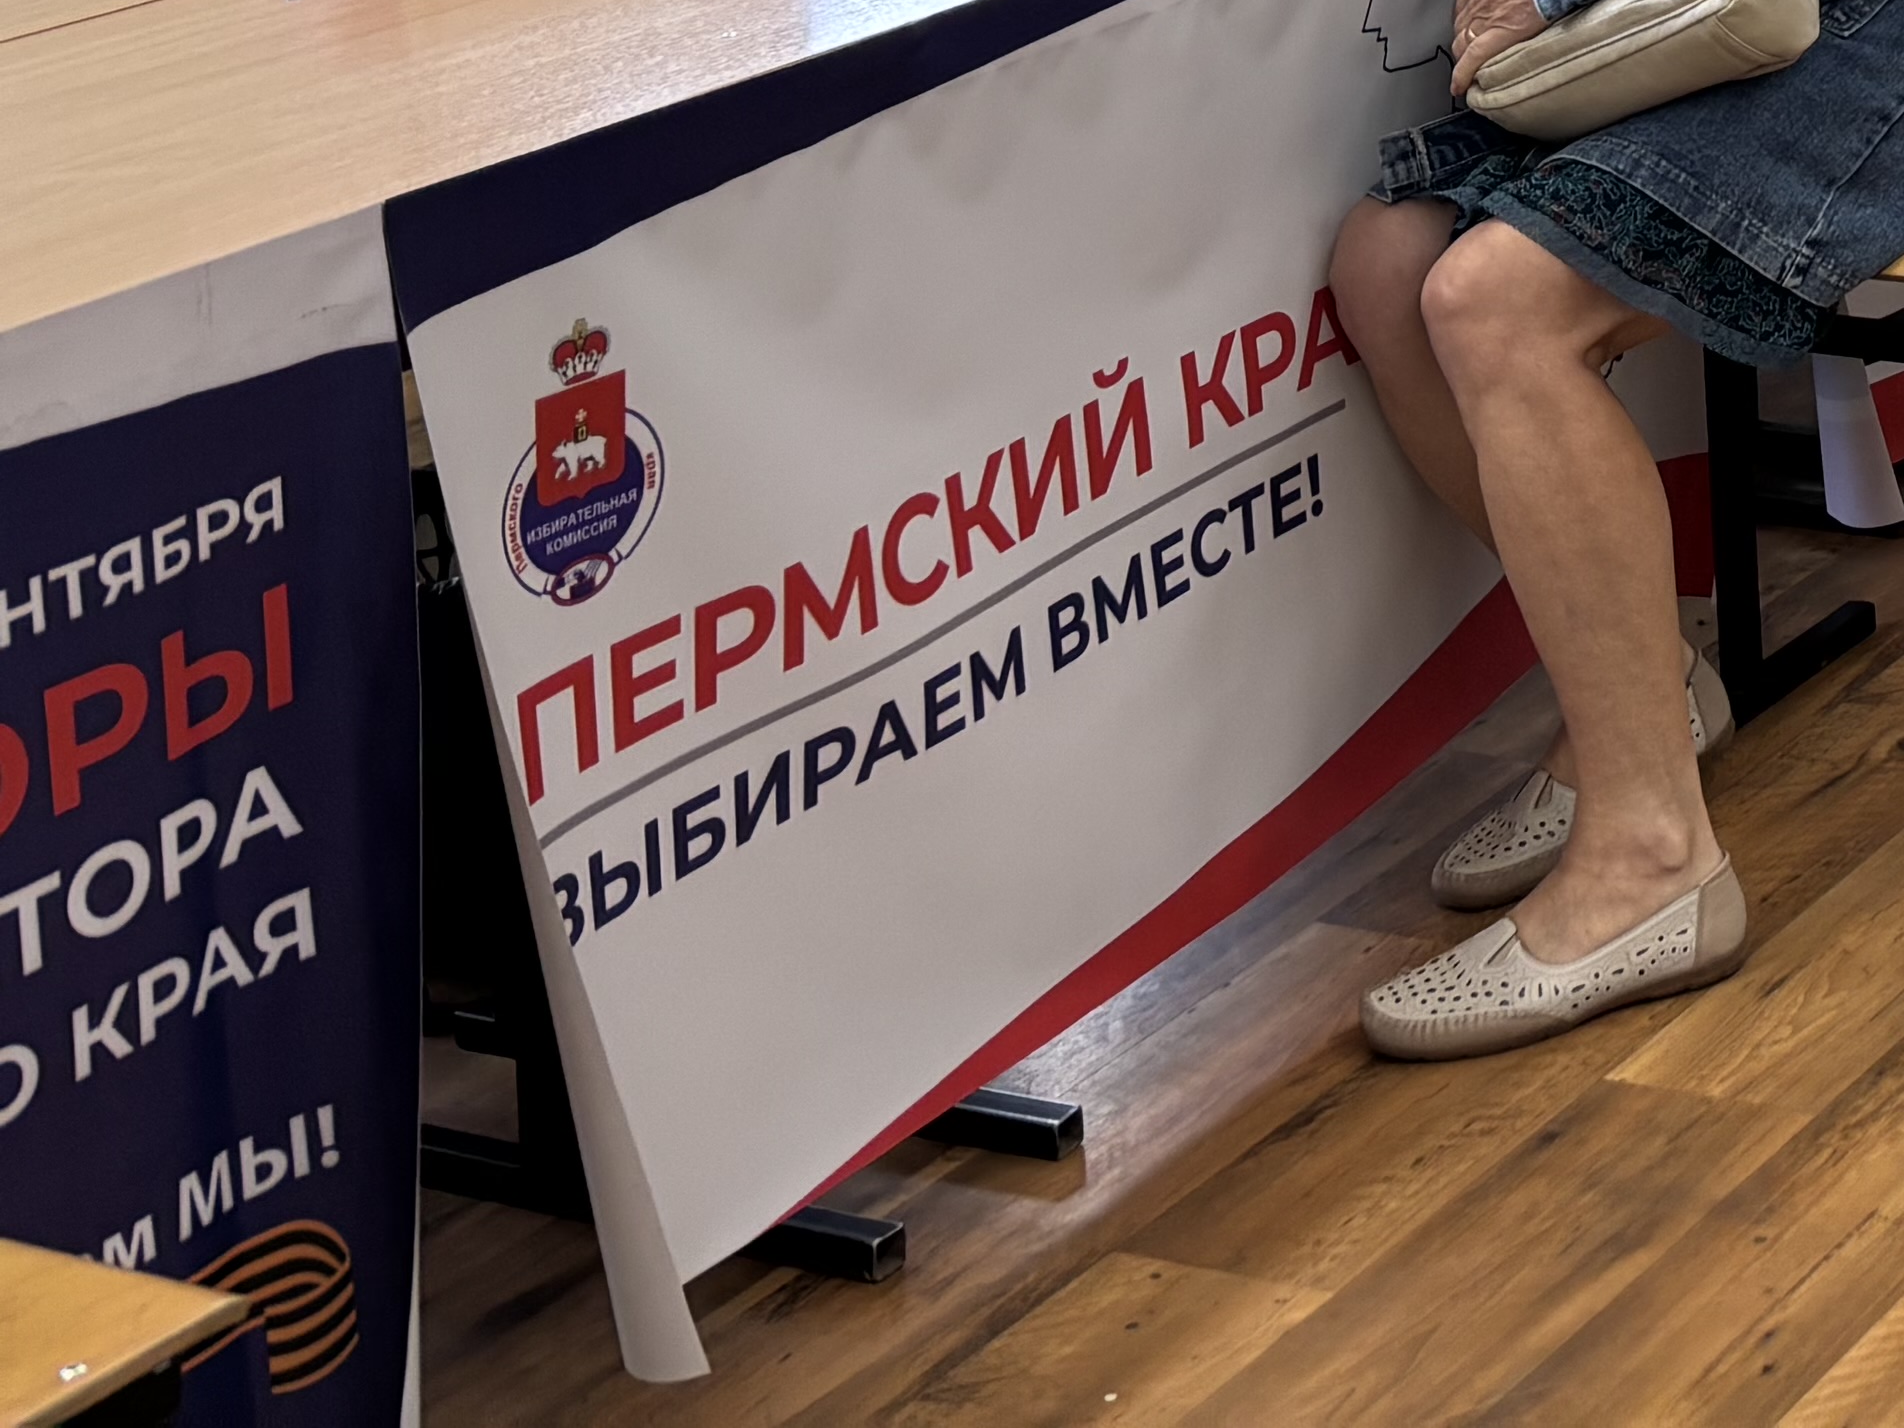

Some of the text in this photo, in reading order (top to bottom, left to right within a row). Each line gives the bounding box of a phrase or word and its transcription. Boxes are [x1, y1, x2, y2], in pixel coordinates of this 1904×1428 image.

[0, 475, 285, 648] НТЯБРЯ
[508, 483, 527, 575] Пермского
[518, 355, 1153, 807] ПЕРМСКИЙ
[1179, 286, 1364, 449] КРА
[527, 488, 638, 544] ИЗБИРАТЕЛЬНАЯ
[546, 515, 618, 556] КОМИССИЯ
[1048, 454, 1325, 673] ВМЕСТЕ!
[71, 887, 317, 1082] КРАЯ
[176, 1103, 341, 1242] МЫ!
